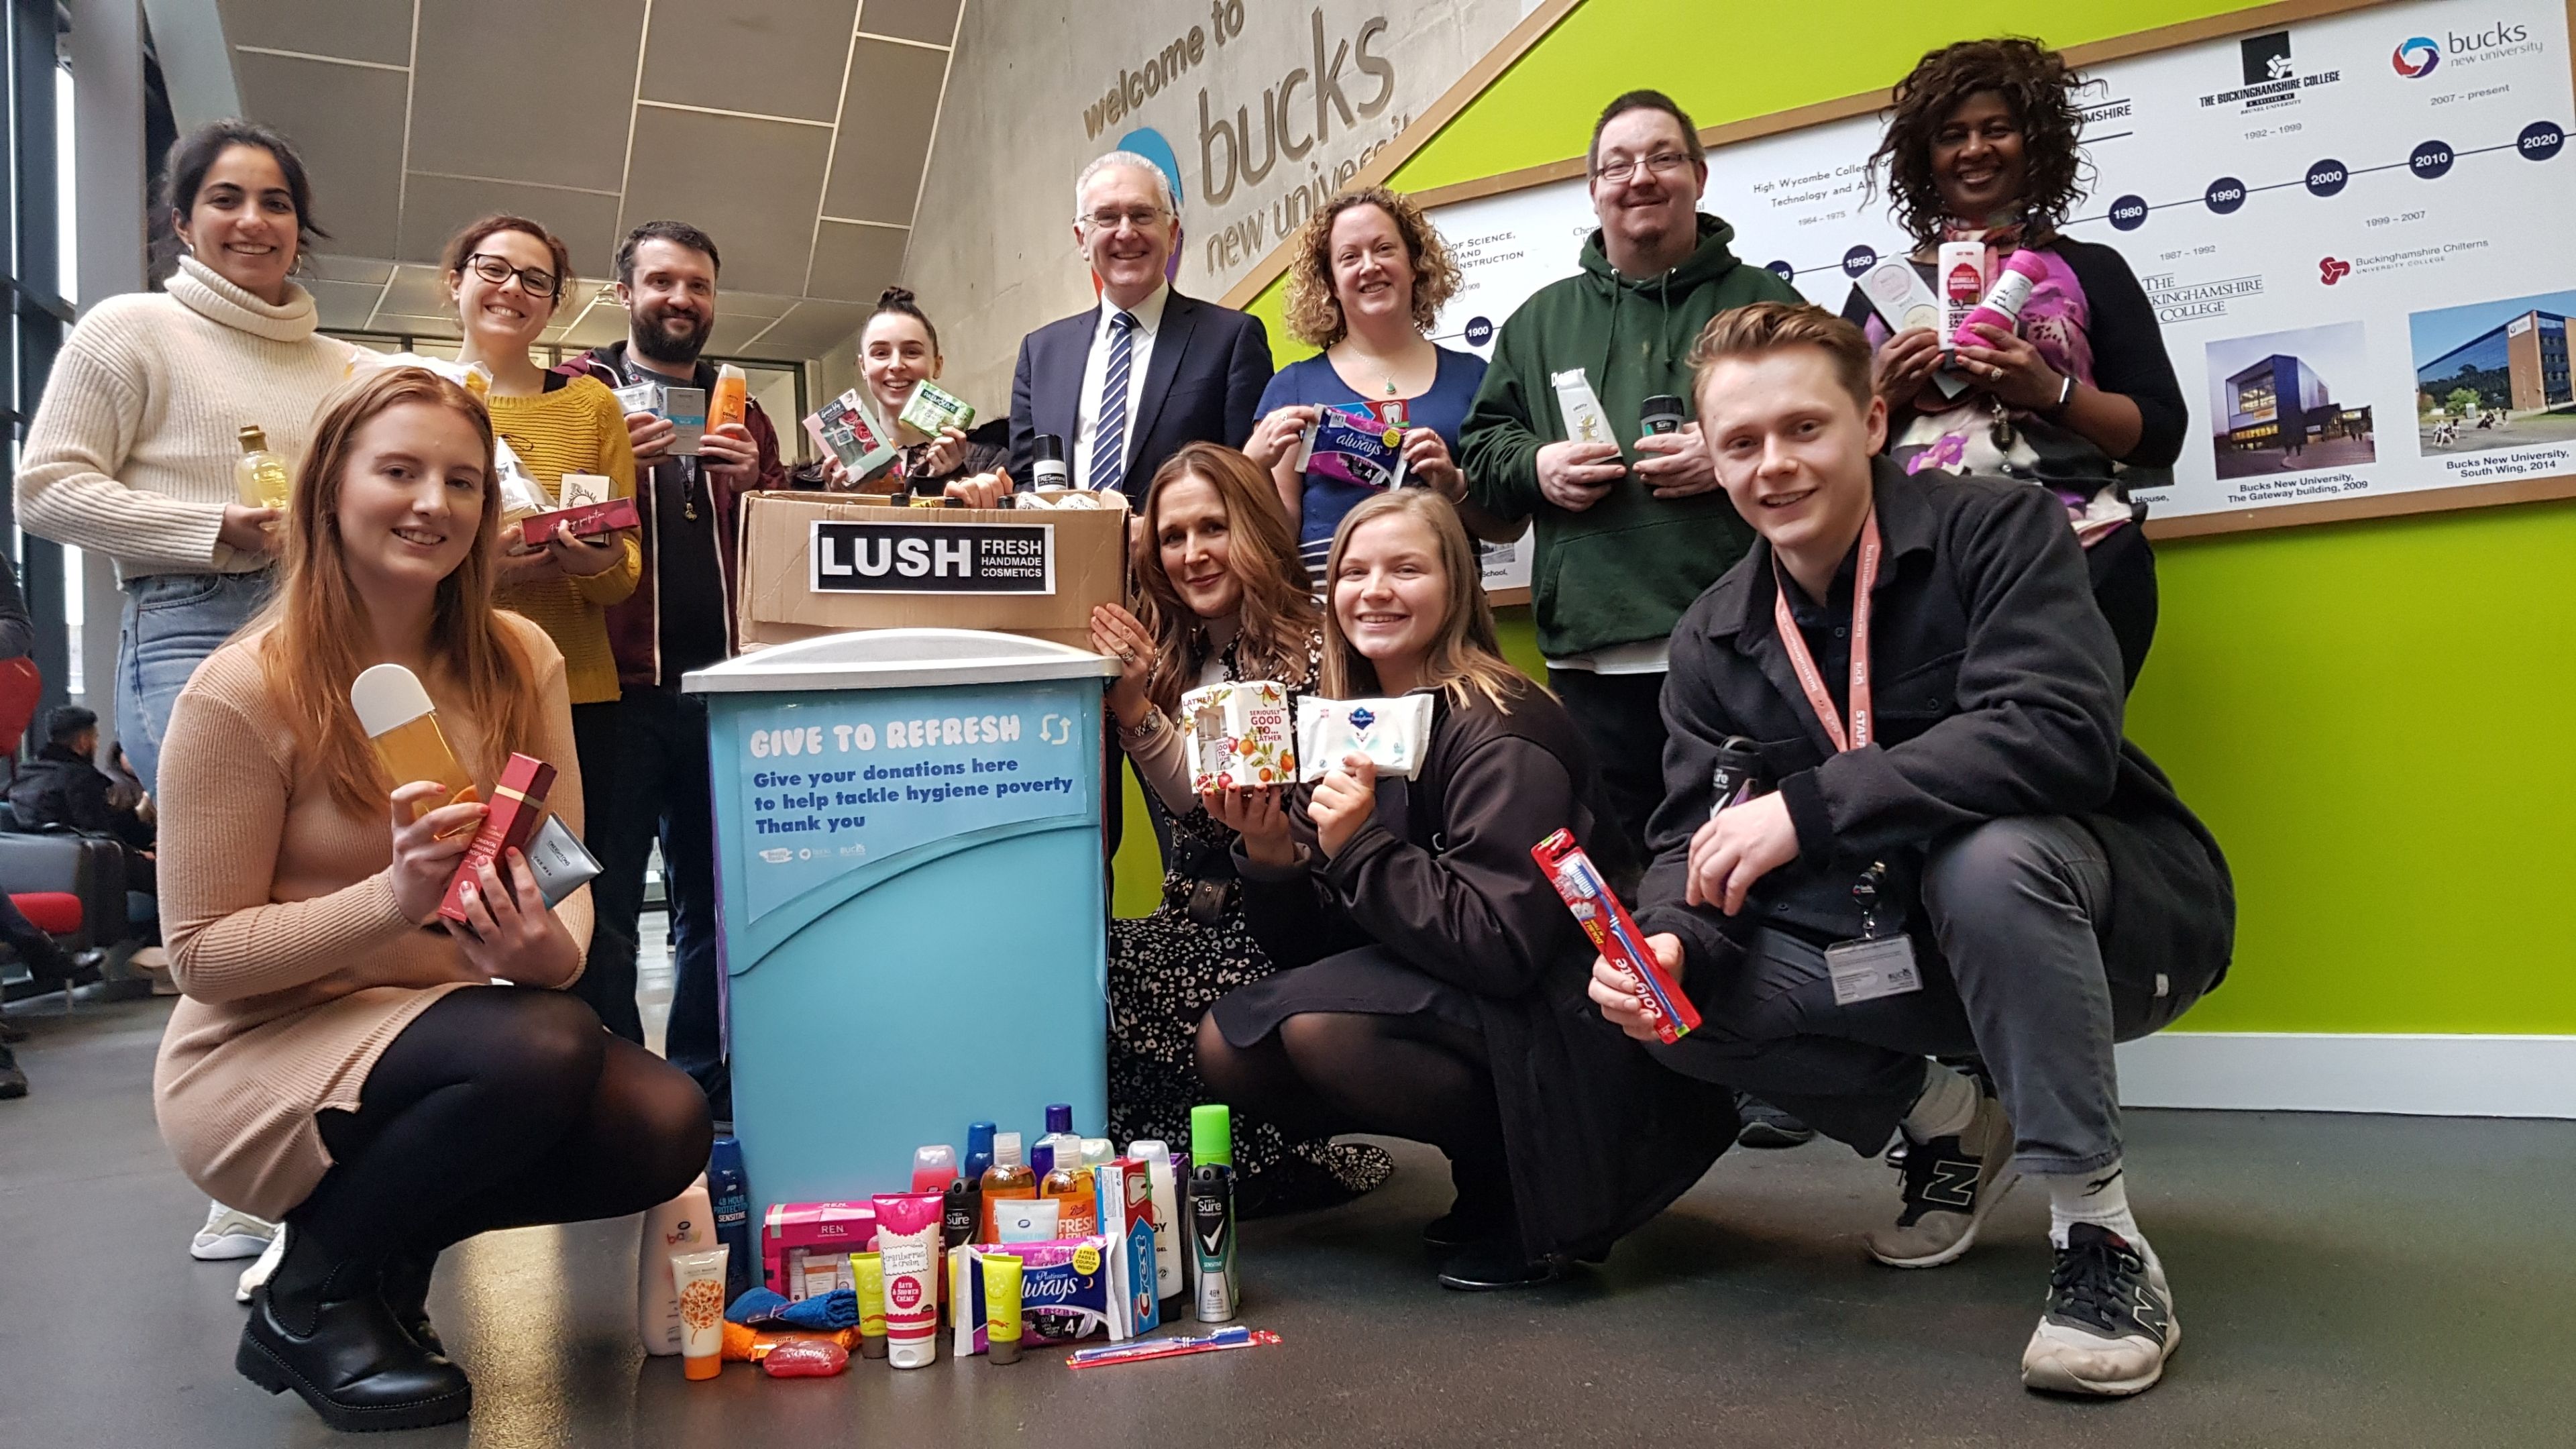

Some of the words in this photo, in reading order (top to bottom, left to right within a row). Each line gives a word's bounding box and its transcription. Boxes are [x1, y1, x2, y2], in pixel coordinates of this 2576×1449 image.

[2449, 21, 2528, 54] bucks
[2451, 54, 2476, 67] new
[2480, 40, 2544, 61] university
[1083, 24, 1205, 141] welcome
[1210, 0, 1244, 47] to
[2199, 96, 2216, 108] THE
[2217, 78, 2301, 104] BUCKINGHAMSHIRE
[2304, 70, 2341, 88] COLLEGE
[2430, 95, 2455, 106] 2007
[2468, 84, 2510, 101] present
[1198, 5, 1394, 206] bucks
[2245, 129, 2267, 140] 1992
[2279, 123, 2302, 134] 1999
[2523, 133, 2559, 149] 2020
[2415, 152, 2449, 167] 2010
[1753, 182, 1775, 194] High
[1778, 172, 1831, 189] Wycombe
[1835, 163, 1872, 176] Colleg
[2310, 170, 2343, 185] 2000
[1771, 190, 1828, 208] Technology
[1833, 182, 1852, 195] and
[2210, 189, 2241, 203] 1990
[2114, 205, 2143, 219] 1980
[2365, 217, 2390, 227] 1999
[2401, 210, 2426, 222] 2007
[1206, 208, 1265, 276] new
[1460, 249, 1481, 260] AND
[2159, 250, 2182, 262] 1987
[2193, 245, 2216, 256] 1992
[2355, 246, 2441, 266] Buckinghamshire
[2443, 239, 2489, 253] Chilterns
[1846, 256, 1873, 270] 1950
[2356, 262, 2405, 274] UNIVERSITY
[2407, 256, 2446, 267] COLLEGE
[2142, 276, 2176, 291] THE
[2159, 301, 2226, 323] COLLEGE
[1467, 325, 1489, 337] 1900
[924, 391, 956, 413] PALMOLIVE
[1336, 432, 1383, 458] always
[2447, 459, 2480, 470] Bucks
[2483, 456, 2508, 466] New
[2511, 449, 2570, 463] University,
[2461, 467, 2493, 478] South
[2496, 464, 2527, 474] Wing,
[2530, 460, 2557, 470] 2014
[2227, 494, 2247, 503] The
[2249, 488, 2294, 502] Gateway
[2296, 484, 2341, 496] building,
[2343, 480, 2369, 490] 2009
[2239, 482, 2271, 493] Bucks
[2274, 479, 2297, 490] New
[2300, 473, 2354, 486] University,
[2135, 494, 2169, 504] House,
[981, 539, 1042, 555] FRESH
[821, 537, 971, 578] LUSH
[981, 557, 1042, 567] HANDMADE
[981, 568, 1042, 578] COSMETICS
[1183, 694, 1213, 706] LATHER
[1250, 716, 1282, 725] GOOD
[1855, 710, 1866, 748] STAFF
[750, 726, 823, 759] GIVE
[833, 722, 876, 753] TO
[885, 714, 1020, 749] REFRESH
[753, 771, 802, 788] Give
[808, 768, 856, 789] your
[863, 762, 966, 782] donations
[972, 756, 1018, 773] here
[755, 796, 775, 812] to
[783, 792, 829, 812] help
[836, 787, 900, 806] tackle
[906, 783, 989, 803] hygiene
[996, 776, 1073, 798] poverty
[755, 816, 820, 835] Thank
[826, 814, 865, 833] you
[718, 1197, 727, 1205] 48
[1198, 1201, 1222, 1212] Sure
[718, 1210, 746, 1222] SENSITIVE
[947, 1214, 970, 1226] Sure
[1058, 1216, 1096, 1233] FRESH
[821, 1225, 845, 1234] REN
[1134, 1234, 1152, 1318] Crest
[1022, 1274, 1079, 1303] lways
[1065, 1319, 1075, 1334] 4
